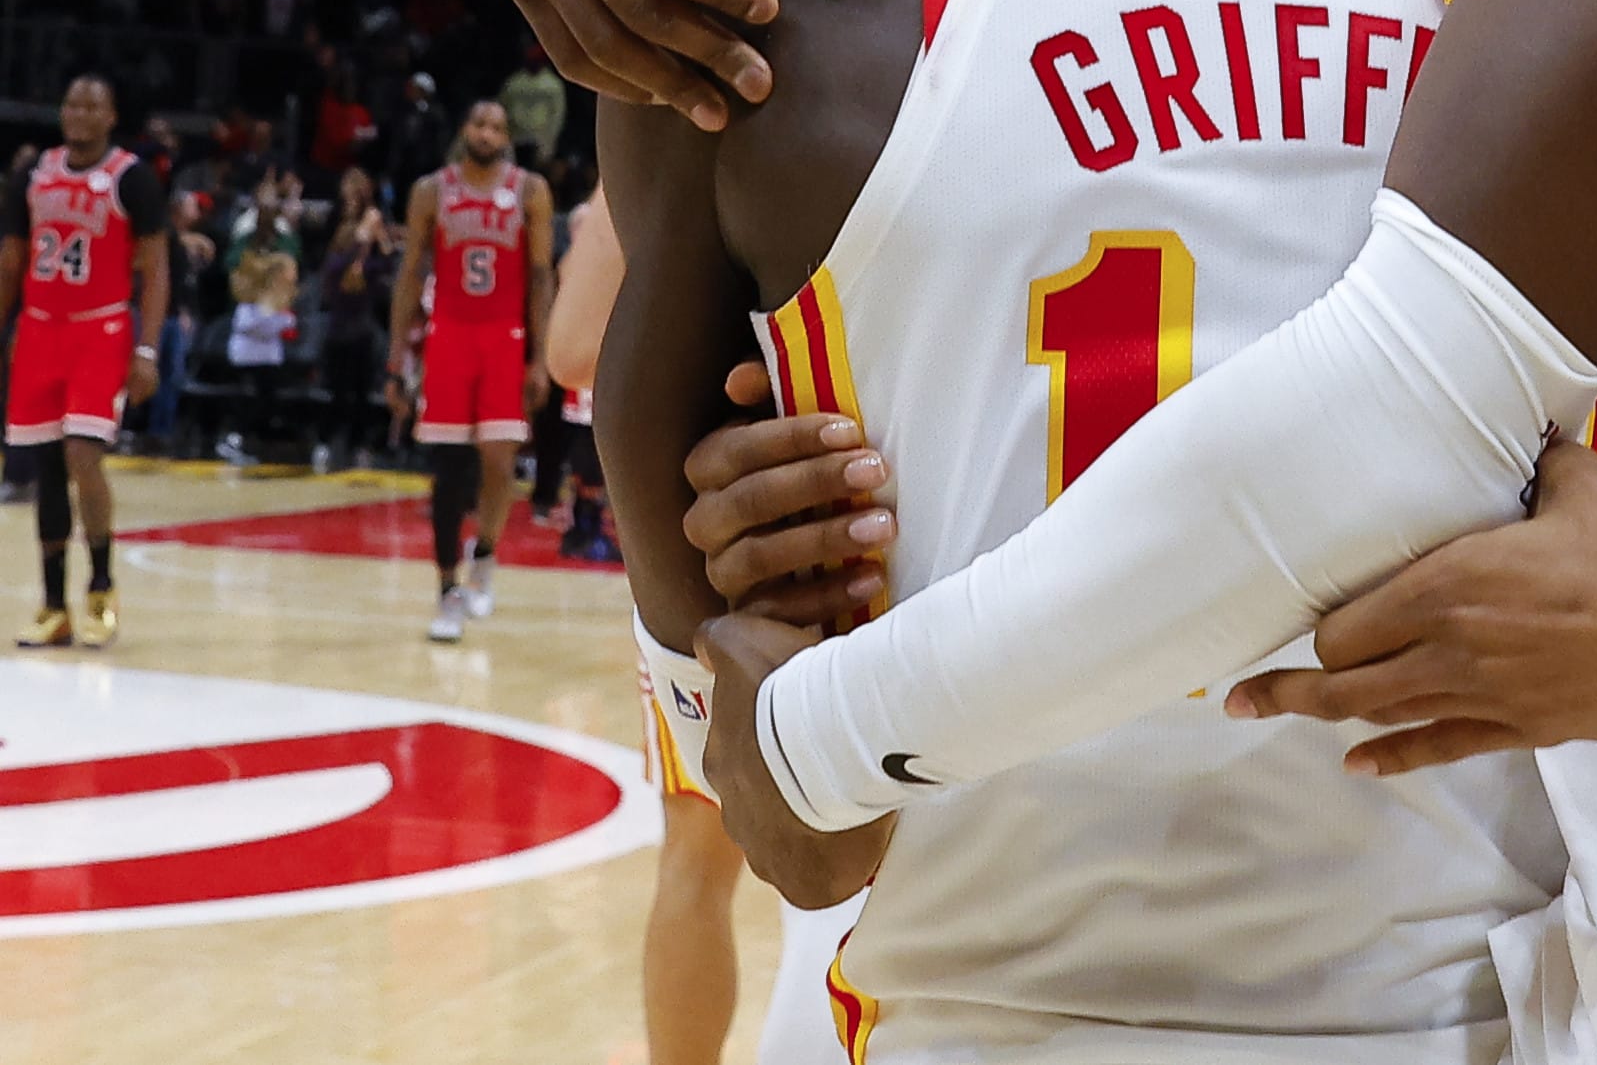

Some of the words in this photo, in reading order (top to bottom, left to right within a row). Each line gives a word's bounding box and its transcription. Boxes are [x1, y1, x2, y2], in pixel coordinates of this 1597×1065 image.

[30, 227, 92, 286] 24
[462, 245, 497, 297] 5
[1026, 229, 1196, 510] 1
